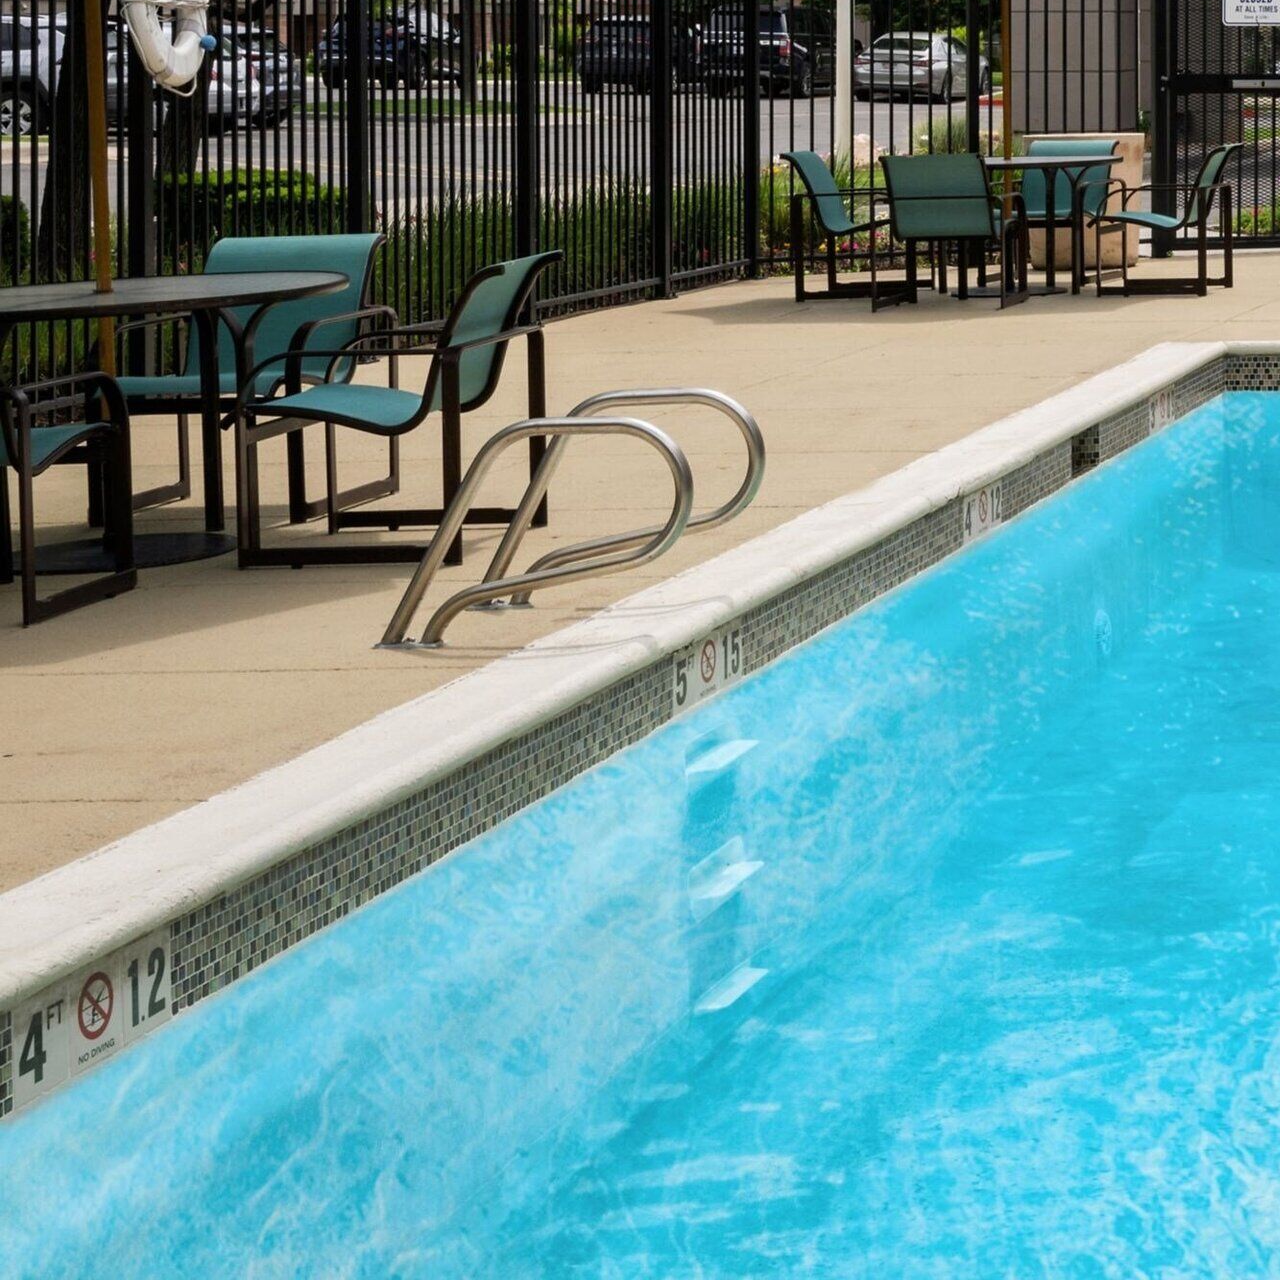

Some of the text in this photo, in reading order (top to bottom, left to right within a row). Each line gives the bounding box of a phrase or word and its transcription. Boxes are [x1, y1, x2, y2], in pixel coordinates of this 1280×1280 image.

[1235, 5, 1278, 13] AT ALL TIMES
[127, 947, 166, 1028] 1.2
[77, 1038, 116, 1066] NO DIVING
